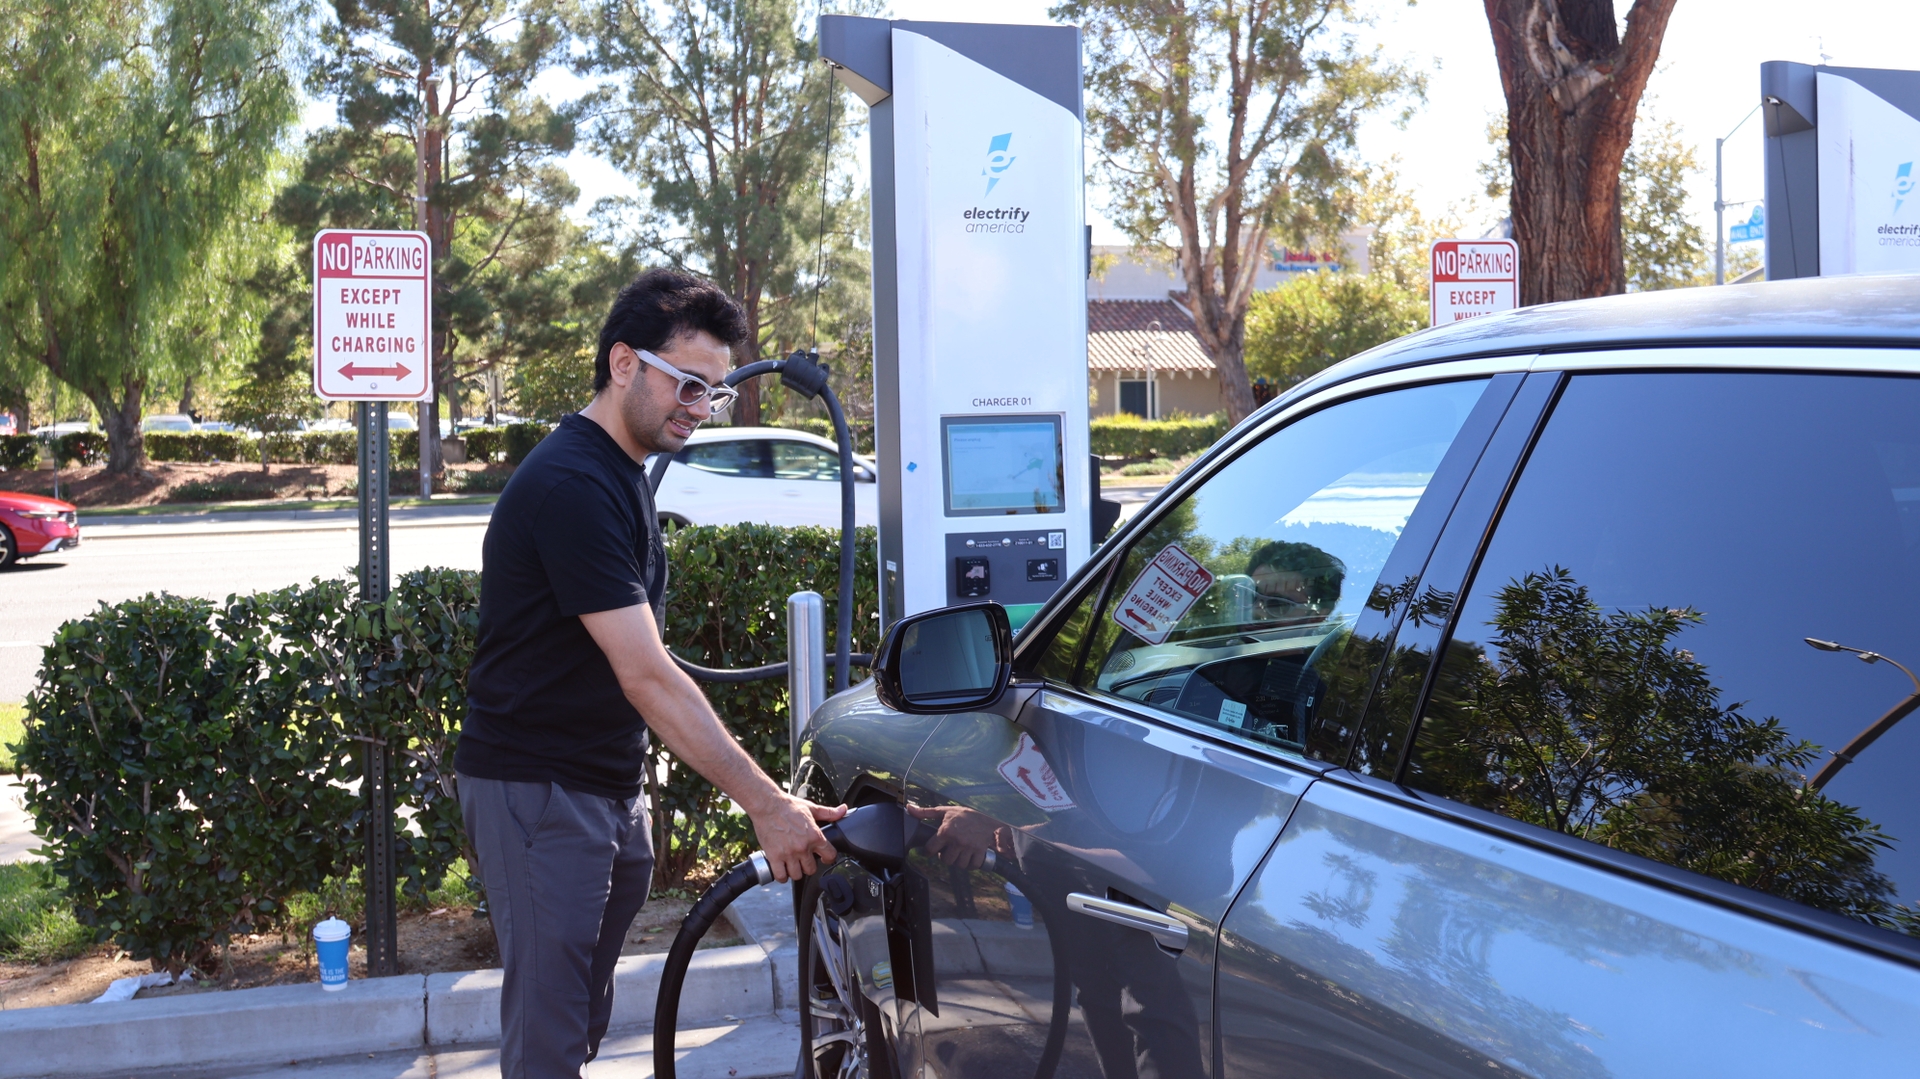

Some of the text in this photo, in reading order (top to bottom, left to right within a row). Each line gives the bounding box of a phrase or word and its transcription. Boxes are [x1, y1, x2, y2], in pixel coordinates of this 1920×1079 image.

[963, 207, 1030, 223] electrify
[965, 222, 1025, 233] america
[1877, 223, 1920, 238] electrif
[322, 243, 422, 271] NO PARKING
[1435, 250, 1512, 276] NO PARKING
[341, 288, 401, 305] EXCEPT
[1450, 290, 1496, 305] EXCEPT
[346, 312, 395, 328] WHILE
[332, 336, 415, 353] CHARGING
[972, 397, 1032, 407] CHARGER 01
